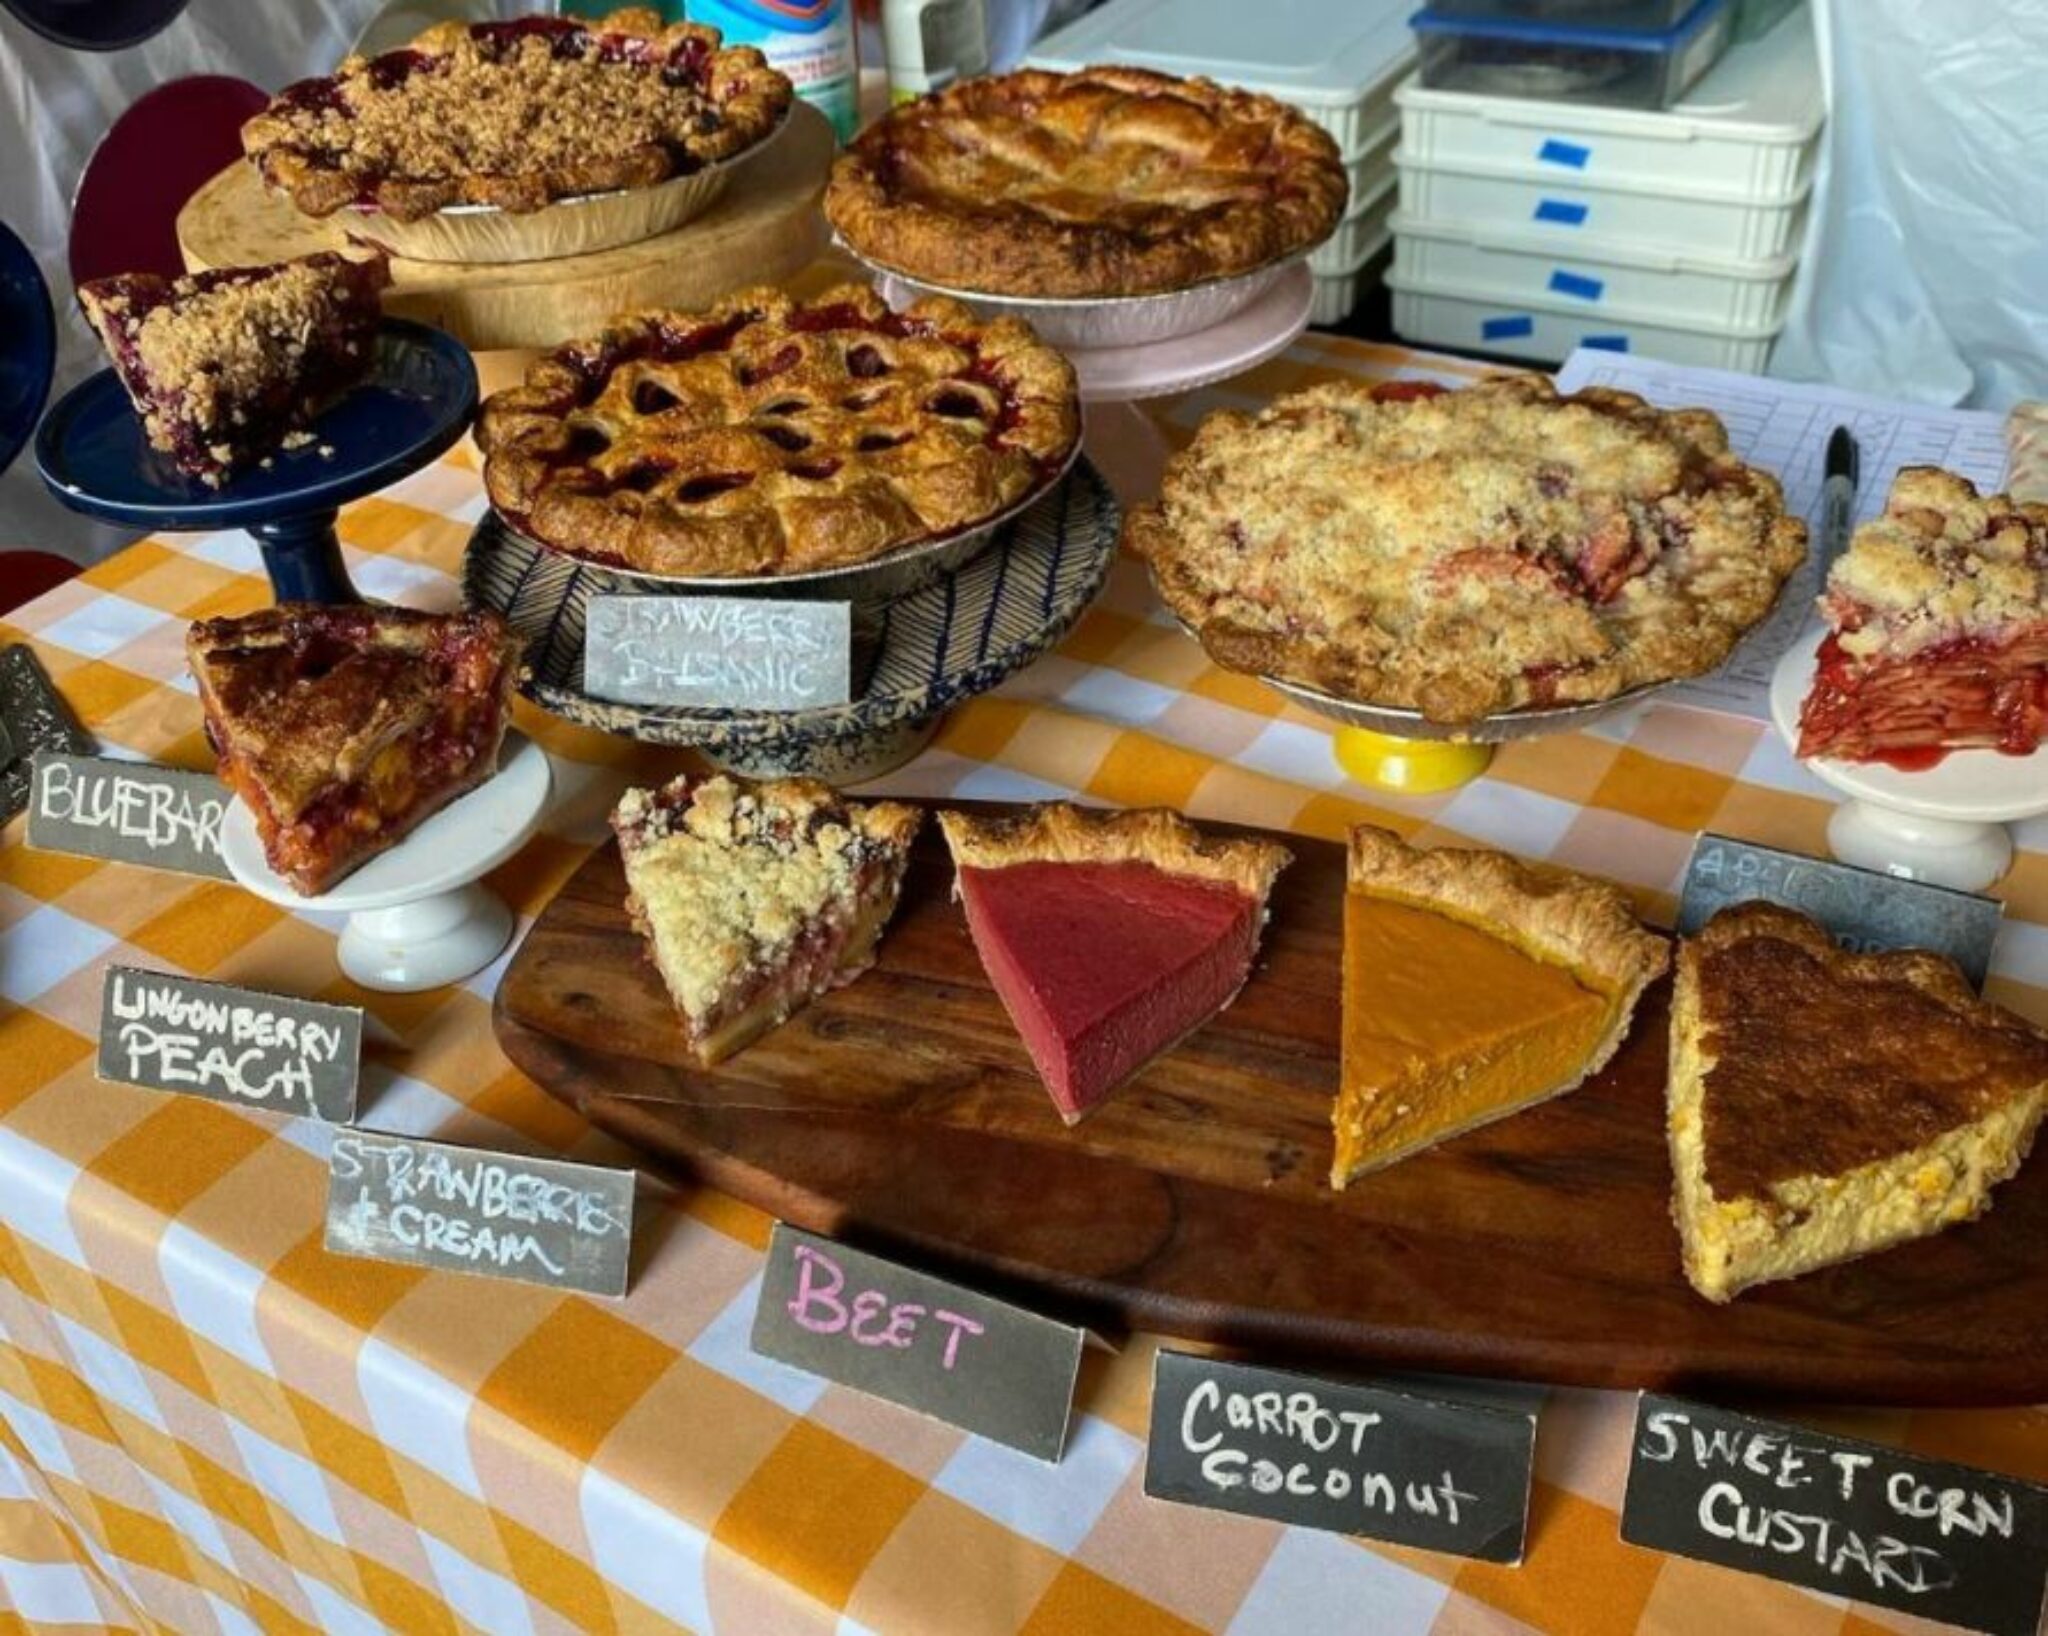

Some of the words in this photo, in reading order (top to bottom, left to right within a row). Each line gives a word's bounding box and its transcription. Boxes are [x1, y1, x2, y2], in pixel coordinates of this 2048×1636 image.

[119, 1022, 321, 1122] PEACH
[389, 1203, 564, 1276] CREAM
[787, 1244, 984, 1370] BEET
[1639, 1411, 1874, 1501] SWEET
[1886, 1472, 2014, 1539] CORN
[1698, 1481, 1957, 1594] CUSTARD
